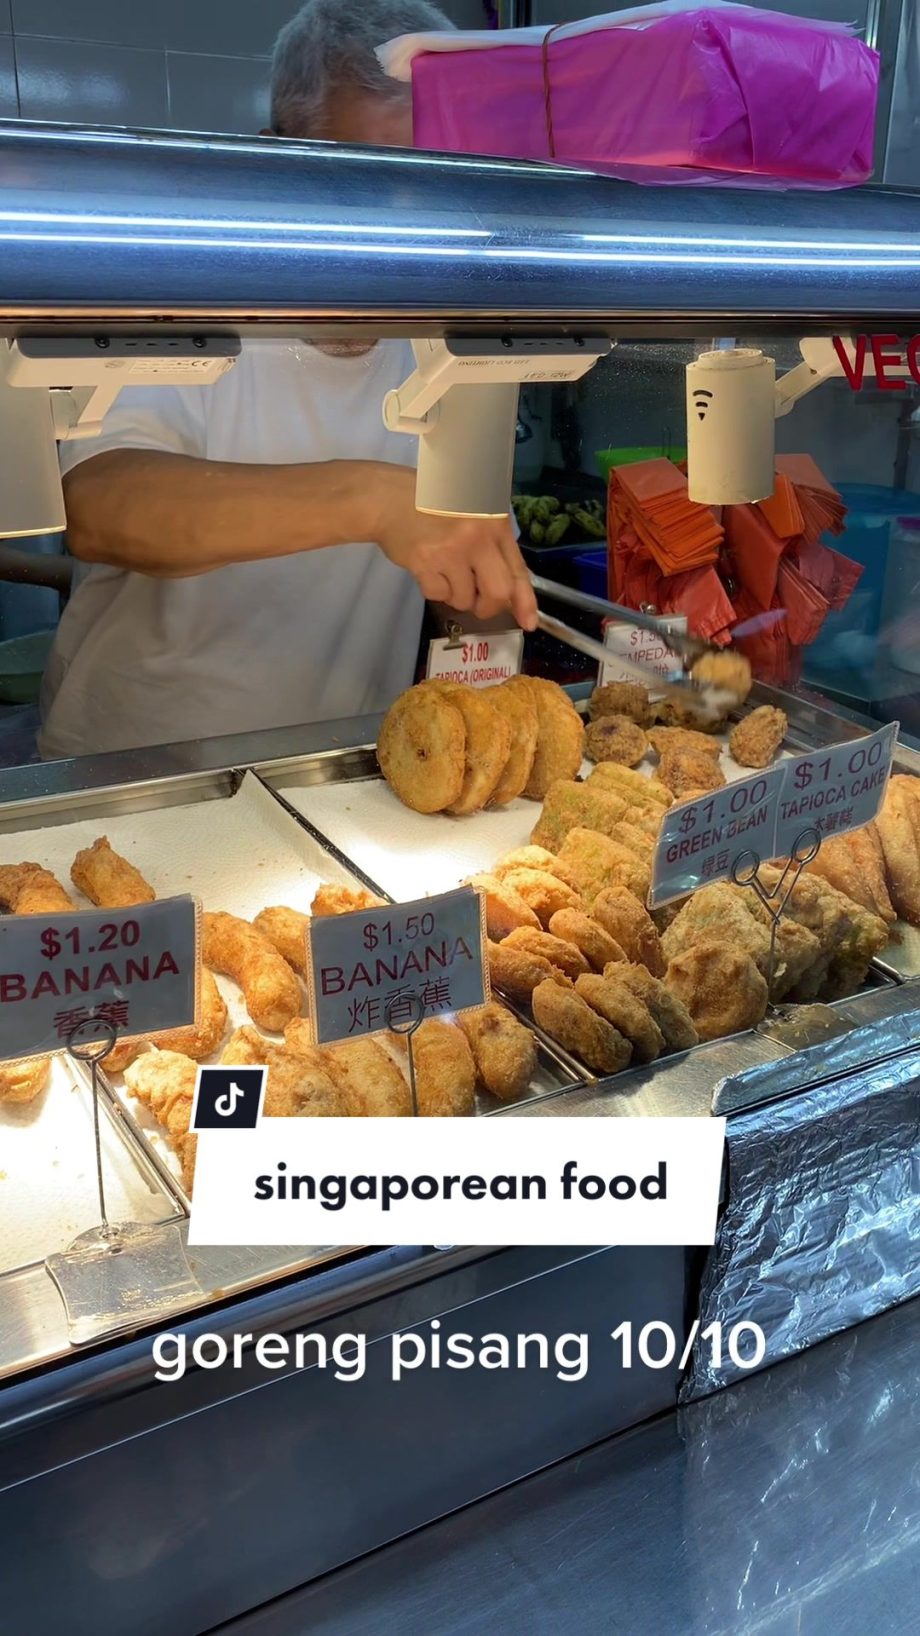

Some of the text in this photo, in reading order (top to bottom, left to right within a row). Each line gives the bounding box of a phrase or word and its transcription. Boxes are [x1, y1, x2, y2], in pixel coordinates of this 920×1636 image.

[462, 641, 489, 665] $1.00
[793, 741, 882, 790] $1.00
[678, 780, 768, 834] $1.00
[781, 767, 886, 820] TAPIOCA CAKE
[666, 806, 768, 863] GREEN BEAN
[40, 919, 141, 961] $1.20
[363, 912, 435, 952] $1.50
[0, 951, 180, 1003] BANANA
[321, 936, 473, 996] BANANA
[347, 975, 453, 1033] 炸香蕉
